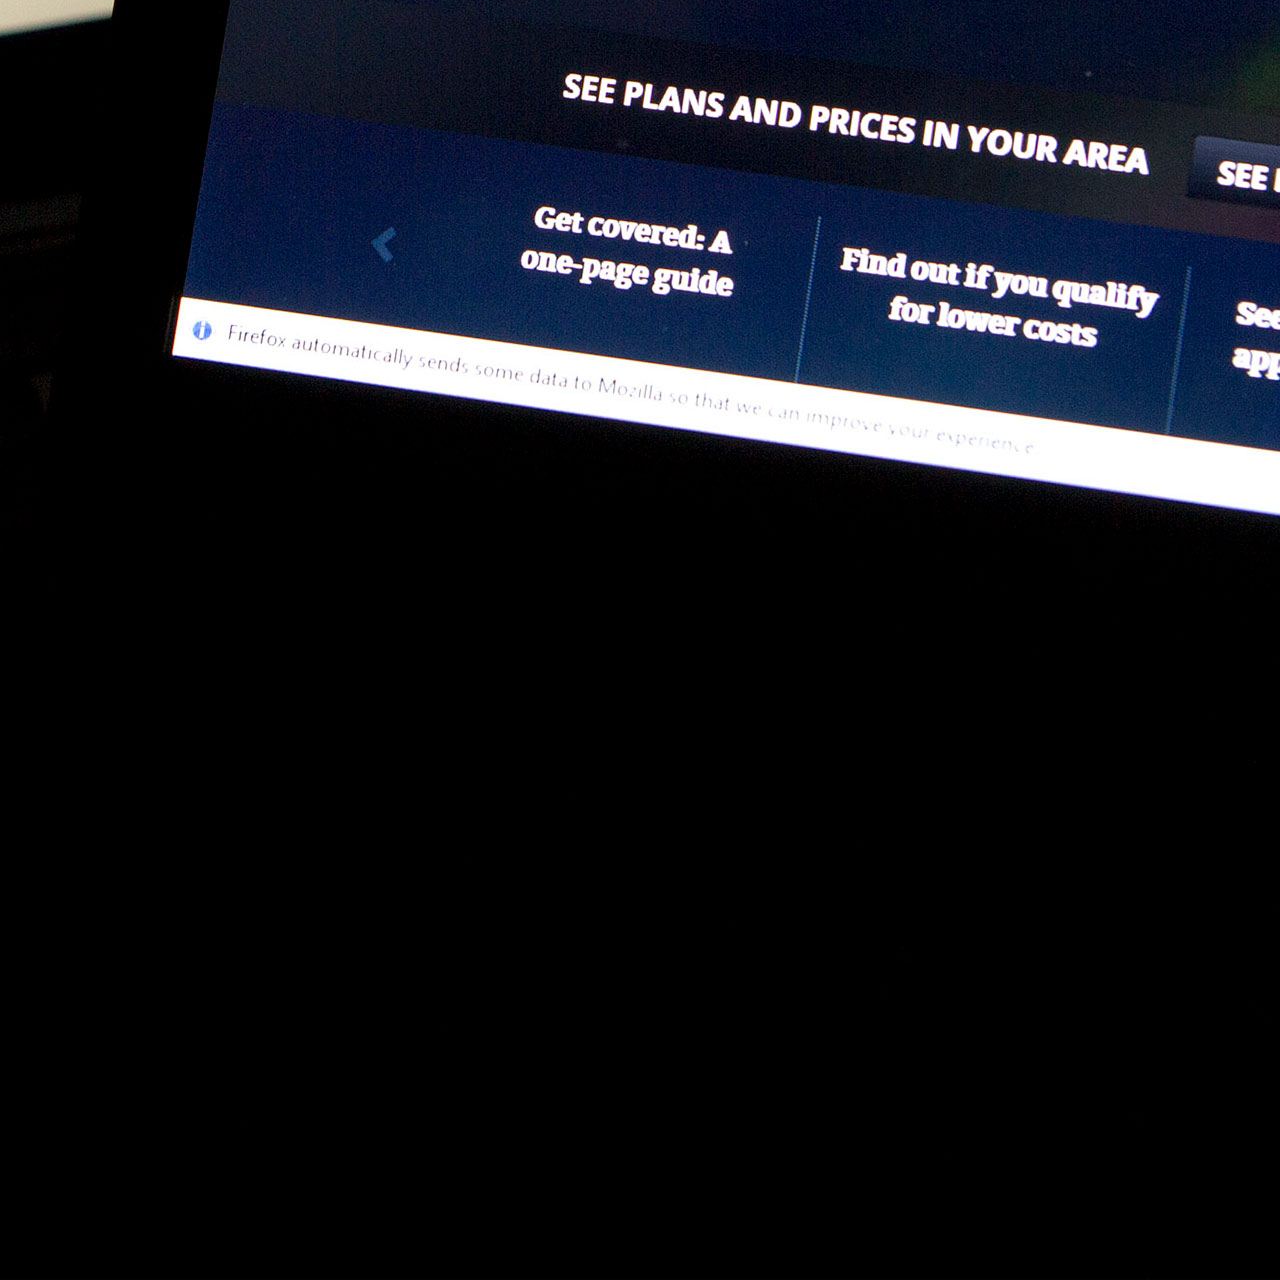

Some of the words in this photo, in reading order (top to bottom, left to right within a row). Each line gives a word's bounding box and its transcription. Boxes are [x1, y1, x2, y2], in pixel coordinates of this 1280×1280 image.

[562, 73, 617, 104] SEE
[623, 81, 725, 118] PLANS
[728, 95, 802, 128] AND
[809, 105, 917, 144] PRICES
[922, 119, 960, 150] IN
[967, 125, 1058, 163] YOUR
[1062, 139, 1150, 176] AREA
[1217, 160, 1270, 191] SEE
[534, 206, 585, 234] Get
[587, 216, 706, 251] covered:
[707, 230, 734, 255] A
[520, 250, 650, 290] one-page
[651, 267, 735, 297] guide
[839, 247, 908, 279] Find
[910, 260, 962, 286] out
[963, 262, 992, 290] if
[992, 270, 1050, 300] you
[1051, 277, 1160, 320] qualify
[887, 295, 936, 325] for
[935, 301, 1022, 337] lower
[1022, 319, 1099, 348] costs
[228, 323, 287, 349] Firefox
[291, 337, 414, 370] automatically
[418, 352, 469, 375] sends
[474, 363, 525, 383] some
[530, 367, 569, 389] data
[573, 373, 593, 393] to
[597, 376, 664, 403] Mozilla
[669, 391, 689, 406] so
[694, 391, 731, 412] that
[736, 401, 763, 416] we
